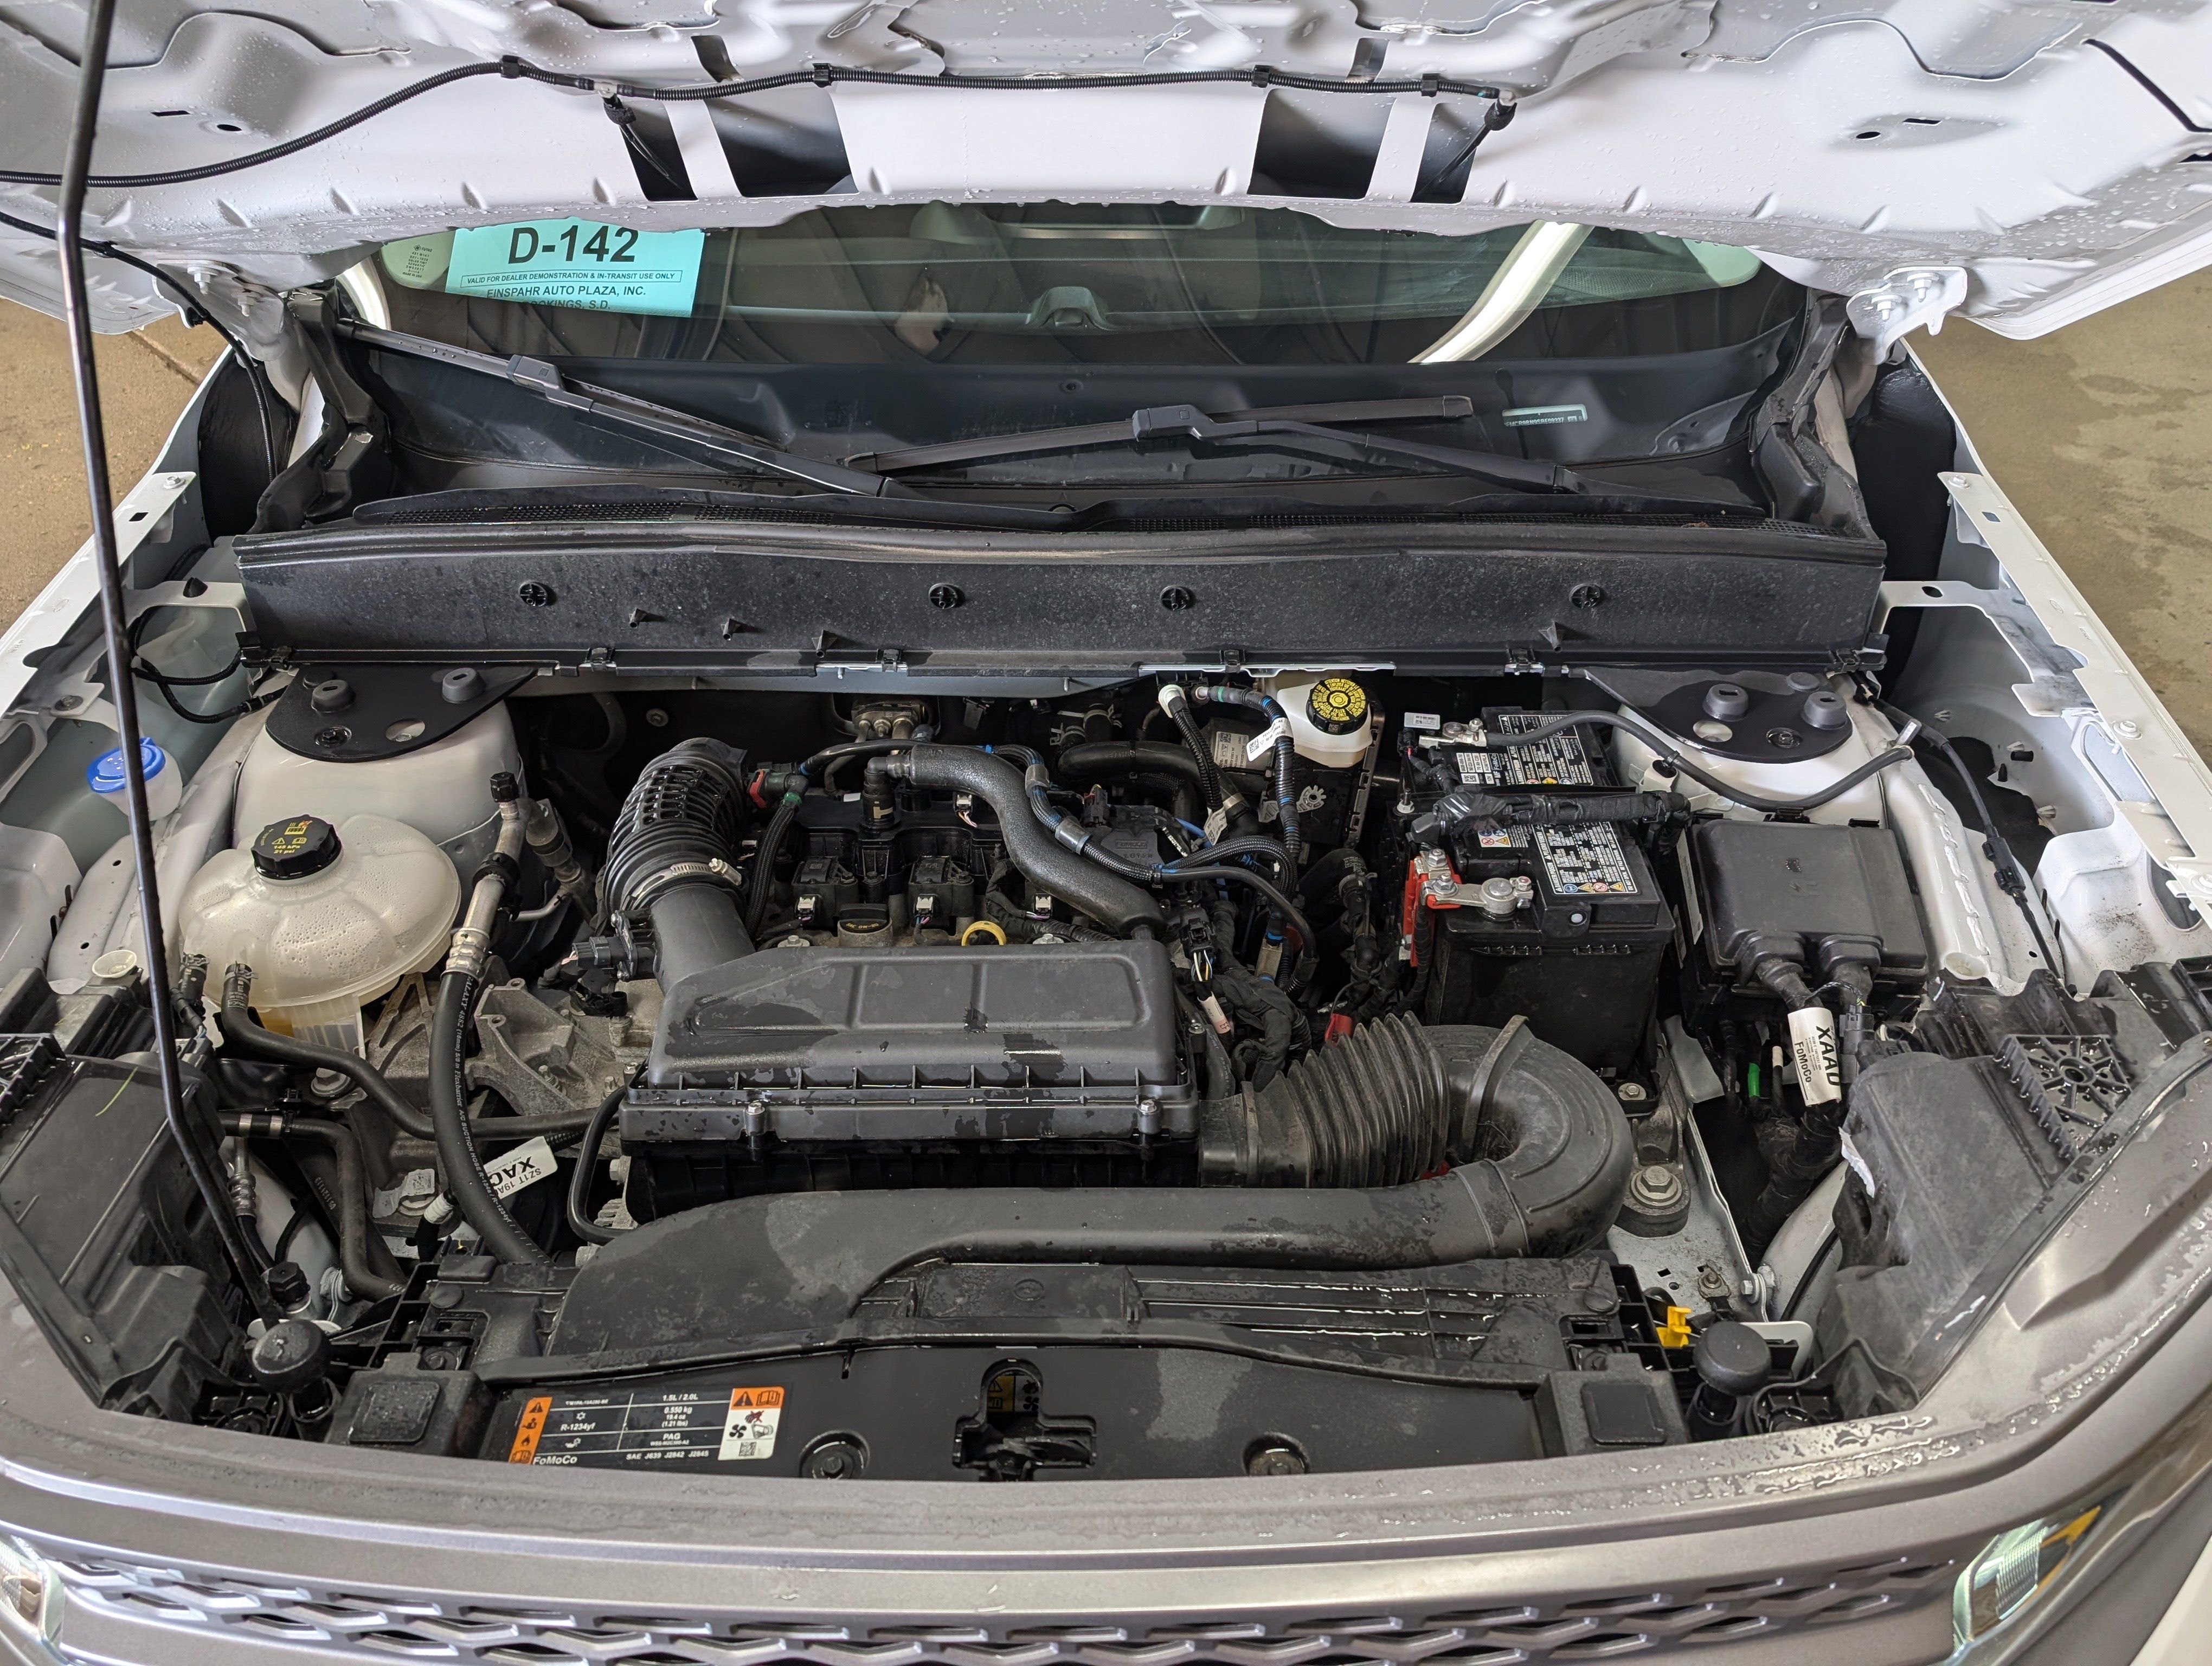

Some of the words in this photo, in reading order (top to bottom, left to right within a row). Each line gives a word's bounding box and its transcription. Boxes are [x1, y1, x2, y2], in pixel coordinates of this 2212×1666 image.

[508, 225, 639, 264] D-142
[487, 286, 540, 298] EINSPAHR
[543, 286, 575, 295] AUTO
[578, 286, 619, 297] PLAZA,
[623, 286, 646, 296] INC.
[589, 300, 610, 309] S.D.
[1795, 1041, 1812, 1083] FoMoCo
[454, 1071, 463, 1106] Flexbarrier
[461, 1122, 474, 1152] SUCTION
[470, 1152, 481, 1171] HOSE
[478, 1171, 492, 1194] R-134a
[491, 1196, 512, 1224] R-1234yf
[519, 1168, 542, 1184] SZ1T
[496, 1181, 515, 1194] 19A
[683, 1406, 692, 1414] kg
[560, 1422, 596, 1432] R-1234yf
[532, 1455, 578, 1465] FoMoCo
